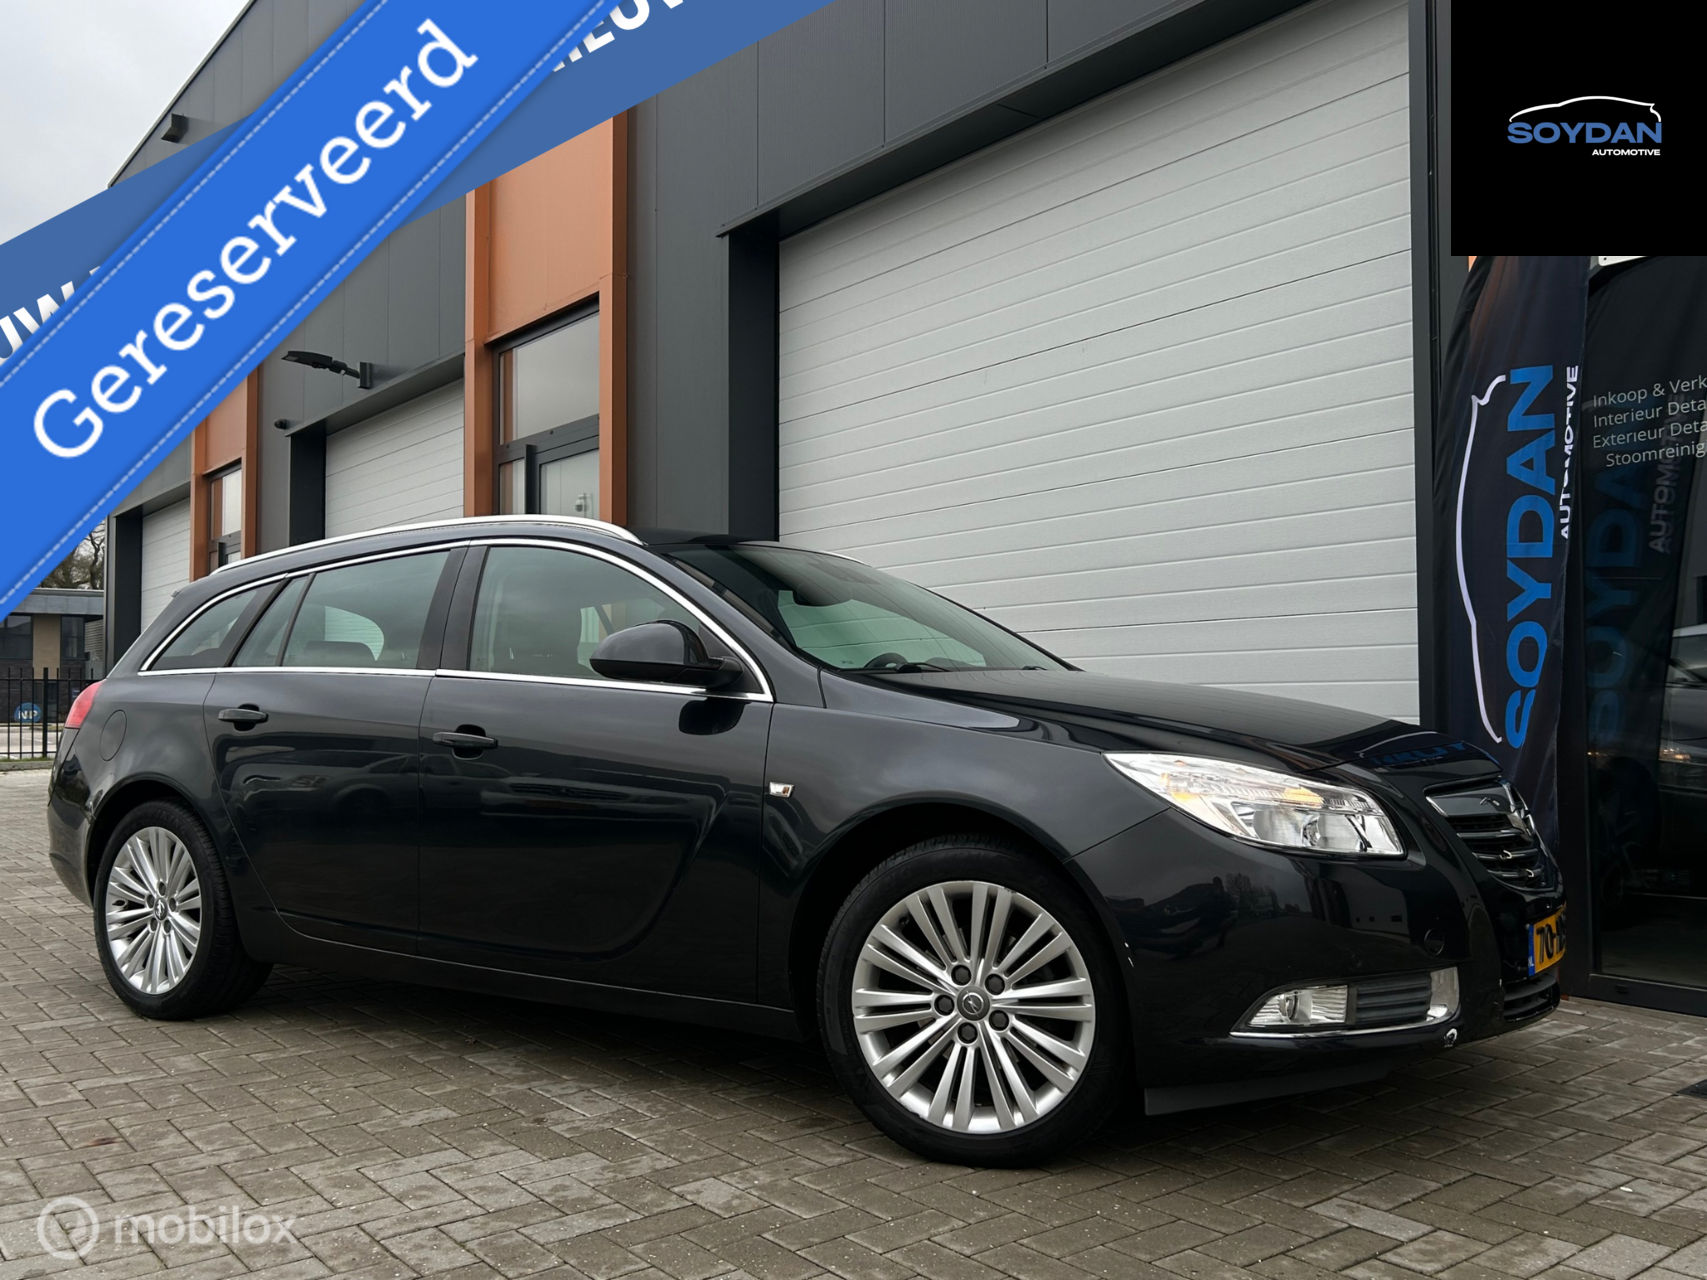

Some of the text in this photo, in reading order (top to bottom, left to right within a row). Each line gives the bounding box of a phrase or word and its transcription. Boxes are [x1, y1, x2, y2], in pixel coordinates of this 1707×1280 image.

[1593, 389, 1648, 408] Inkoop
[1652, 383, 1666, 397] &
[1593, 406, 1663, 428] Interieur
[1593, 427, 1665, 448] Exterieur
[1505, 365, 1555, 749] SOYDAN
